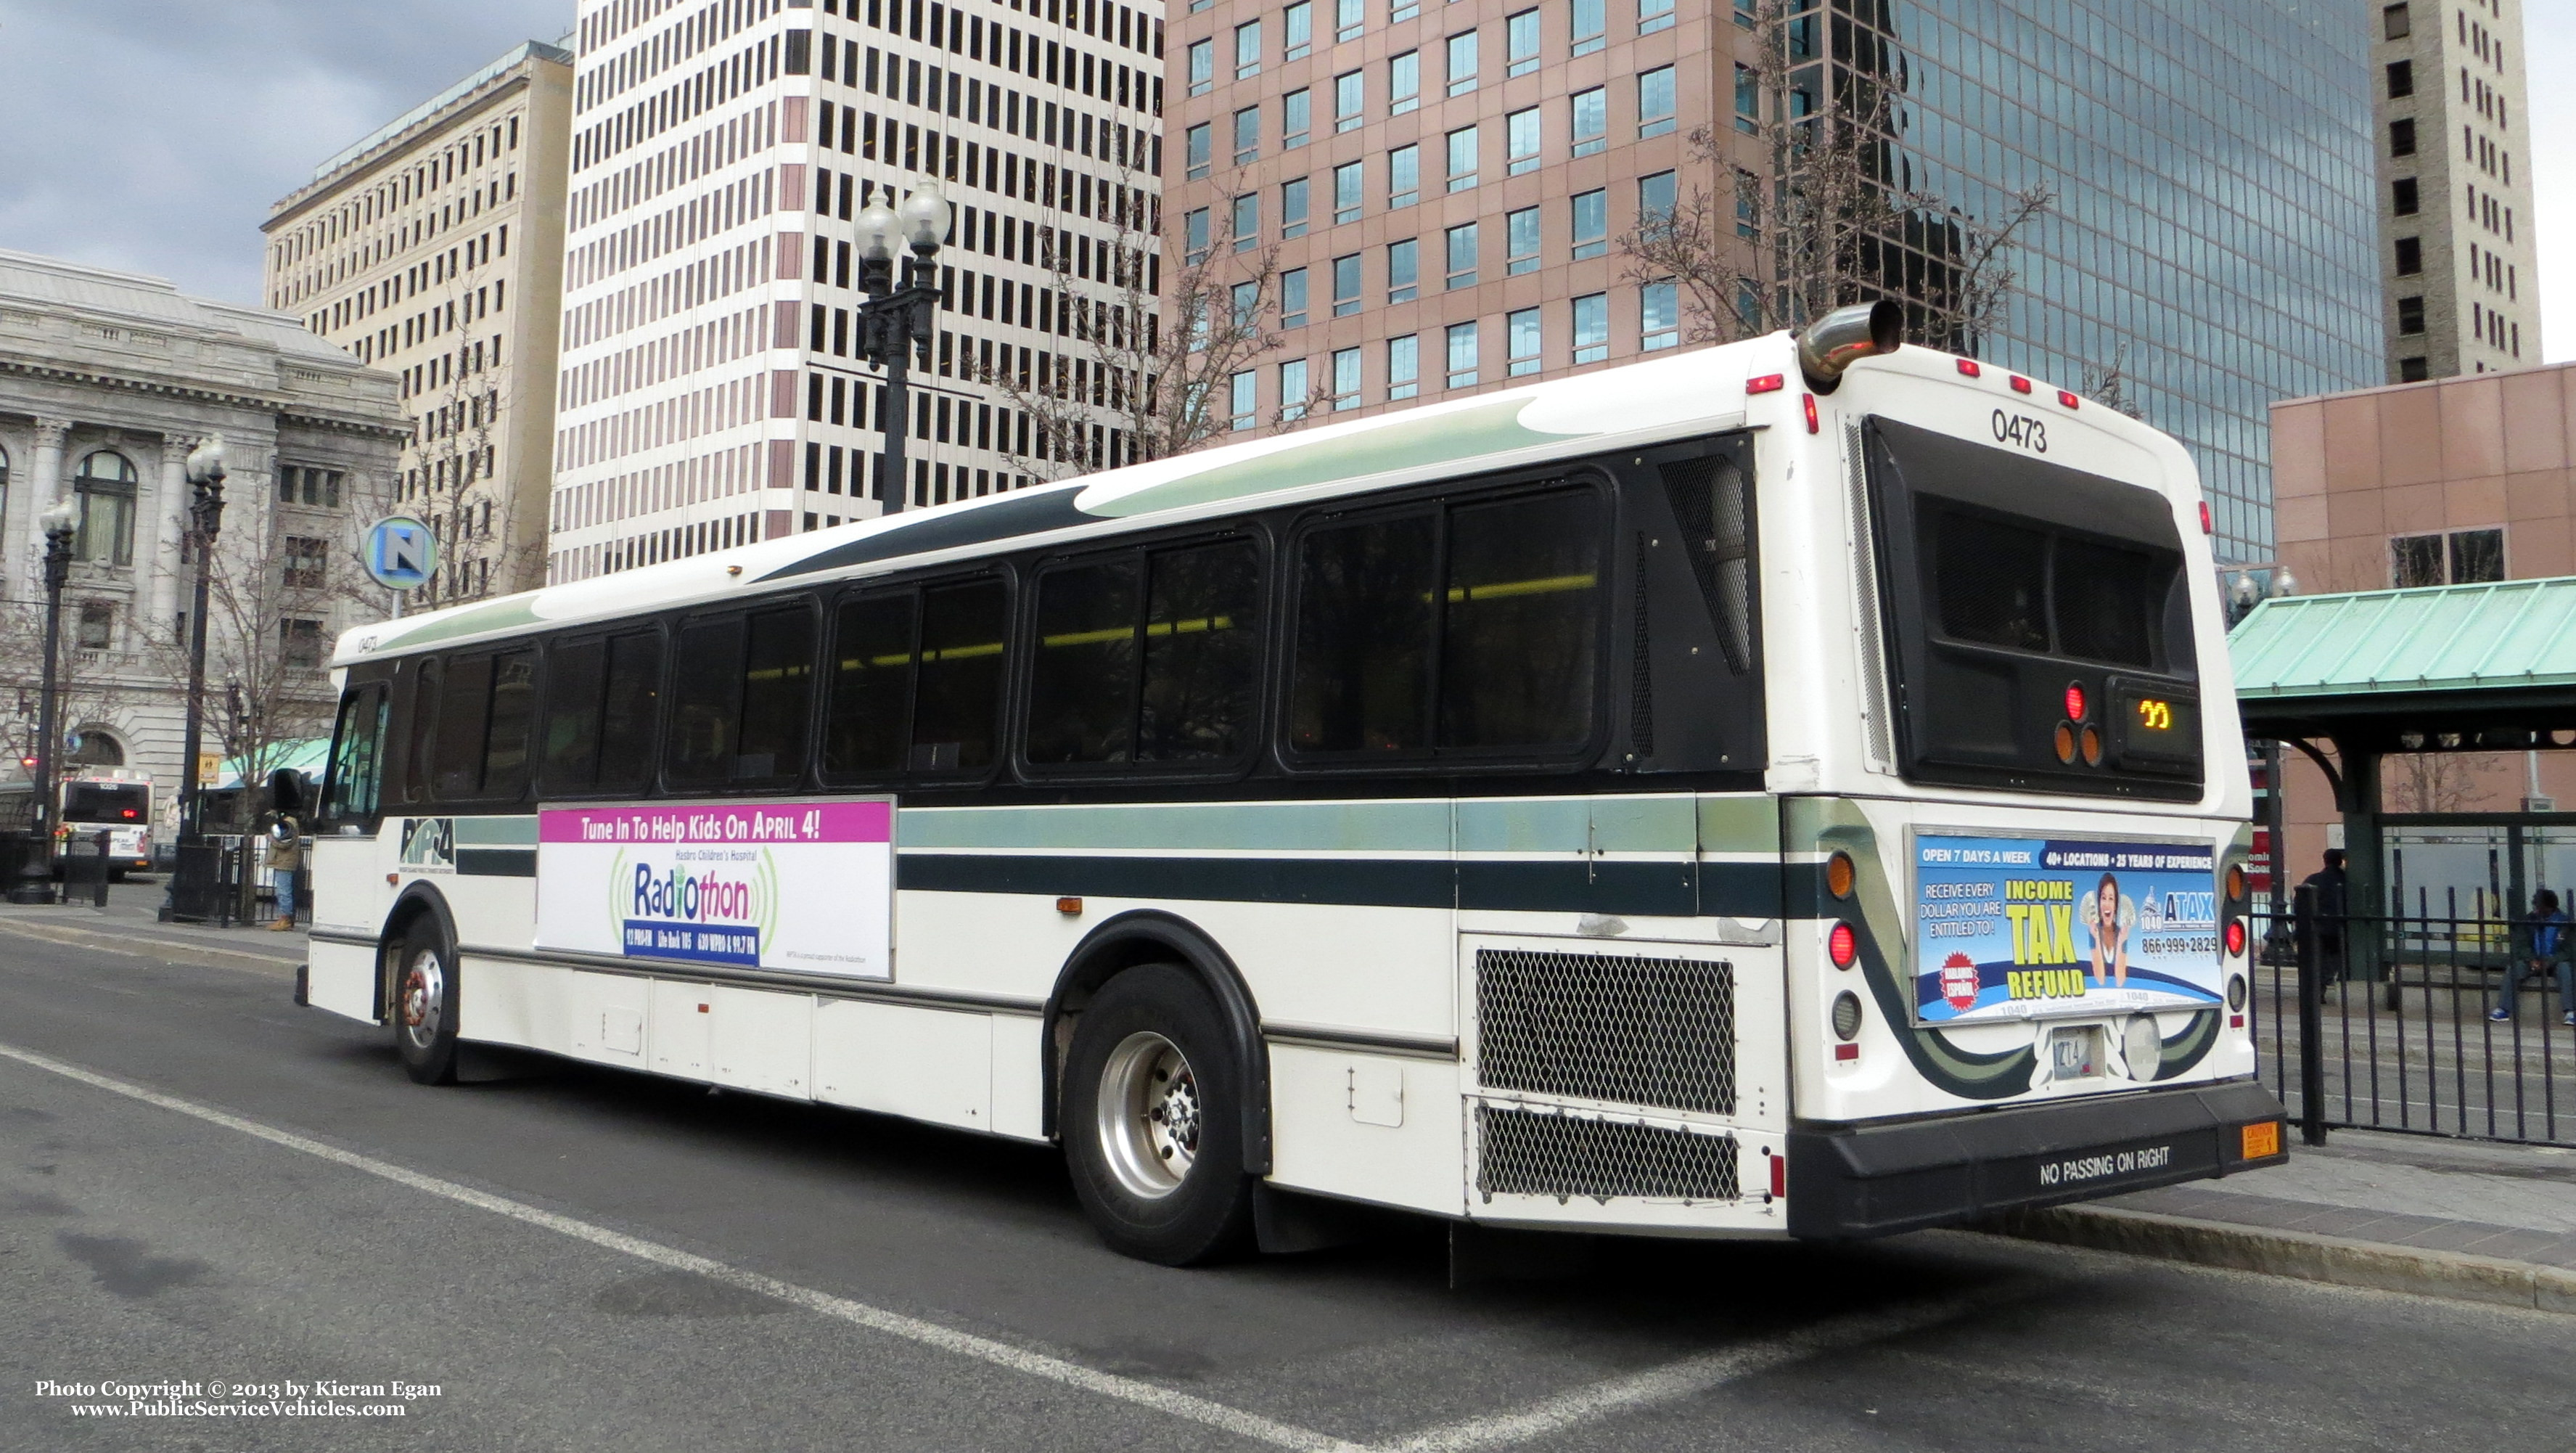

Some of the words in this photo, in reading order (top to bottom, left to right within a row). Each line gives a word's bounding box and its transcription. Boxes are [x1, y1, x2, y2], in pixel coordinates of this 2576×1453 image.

[1992, 409, 2048, 454] 0473
[385, 527, 424, 574] N
[582, 816, 612, 840] Tune
[617, 816, 629, 840] In
[633, 816, 649, 840] To
[652, 814, 685, 843] Help
[689, 814, 721, 840] Kids
[726, 814, 747, 840] On
[752, 811, 797, 840] APRIL
[802, 809, 820, 839] 4!
[676, 850, 697, 861] Hasbro
[698, 850, 729, 861] Children's
[731, 850, 757, 861] Hospital
[1923, 849, 1951, 862] OPEN
[1954, 850, 1961, 862] 7
[1963, 851, 1990, 863] DAYS
[1993, 851, 2001, 863] A
[2003, 851, 2031, 864] WEEK
[2046, 852, 2062, 865] 40+
[2063, 853, 2109, 866] LOCATIONS
[2117, 854, 2126, 867] 25
[2128, 855, 2154, 868] YEARS
[2155, 856, 2165, 869] OF
[2167, 856, 2212, 869] EXPERIENCE
[1926, 883, 1964, 899] RECEIVE
[1965, 883, 1995, 897] EVERY
[2006, 880, 2072, 900] INCOME
[1921, 903, 1959, 919] DOLLAR
[1959, 902, 1981, 916] YOU
[1982, 901, 2001, 914] ARE
[2164, 892, 2215, 922] ATAX
[1930, 921, 1974, 938] ENTITLED
[2141, 917, 2162, 930] 1040
[2006, 904, 2076, 965] TAX
[2006, 970, 2085, 999] REFUND
[2126, 991, 2148, 1002] 1040
[2001, 1004, 2027, 1016] 1040
[2040, 1163, 2059, 1184] NO
[2064, 1155, 2114, 1182] PASSING
[2117, 1152, 2134, 1172] ON
[2138, 1146, 2170, 1169] RIGHT
